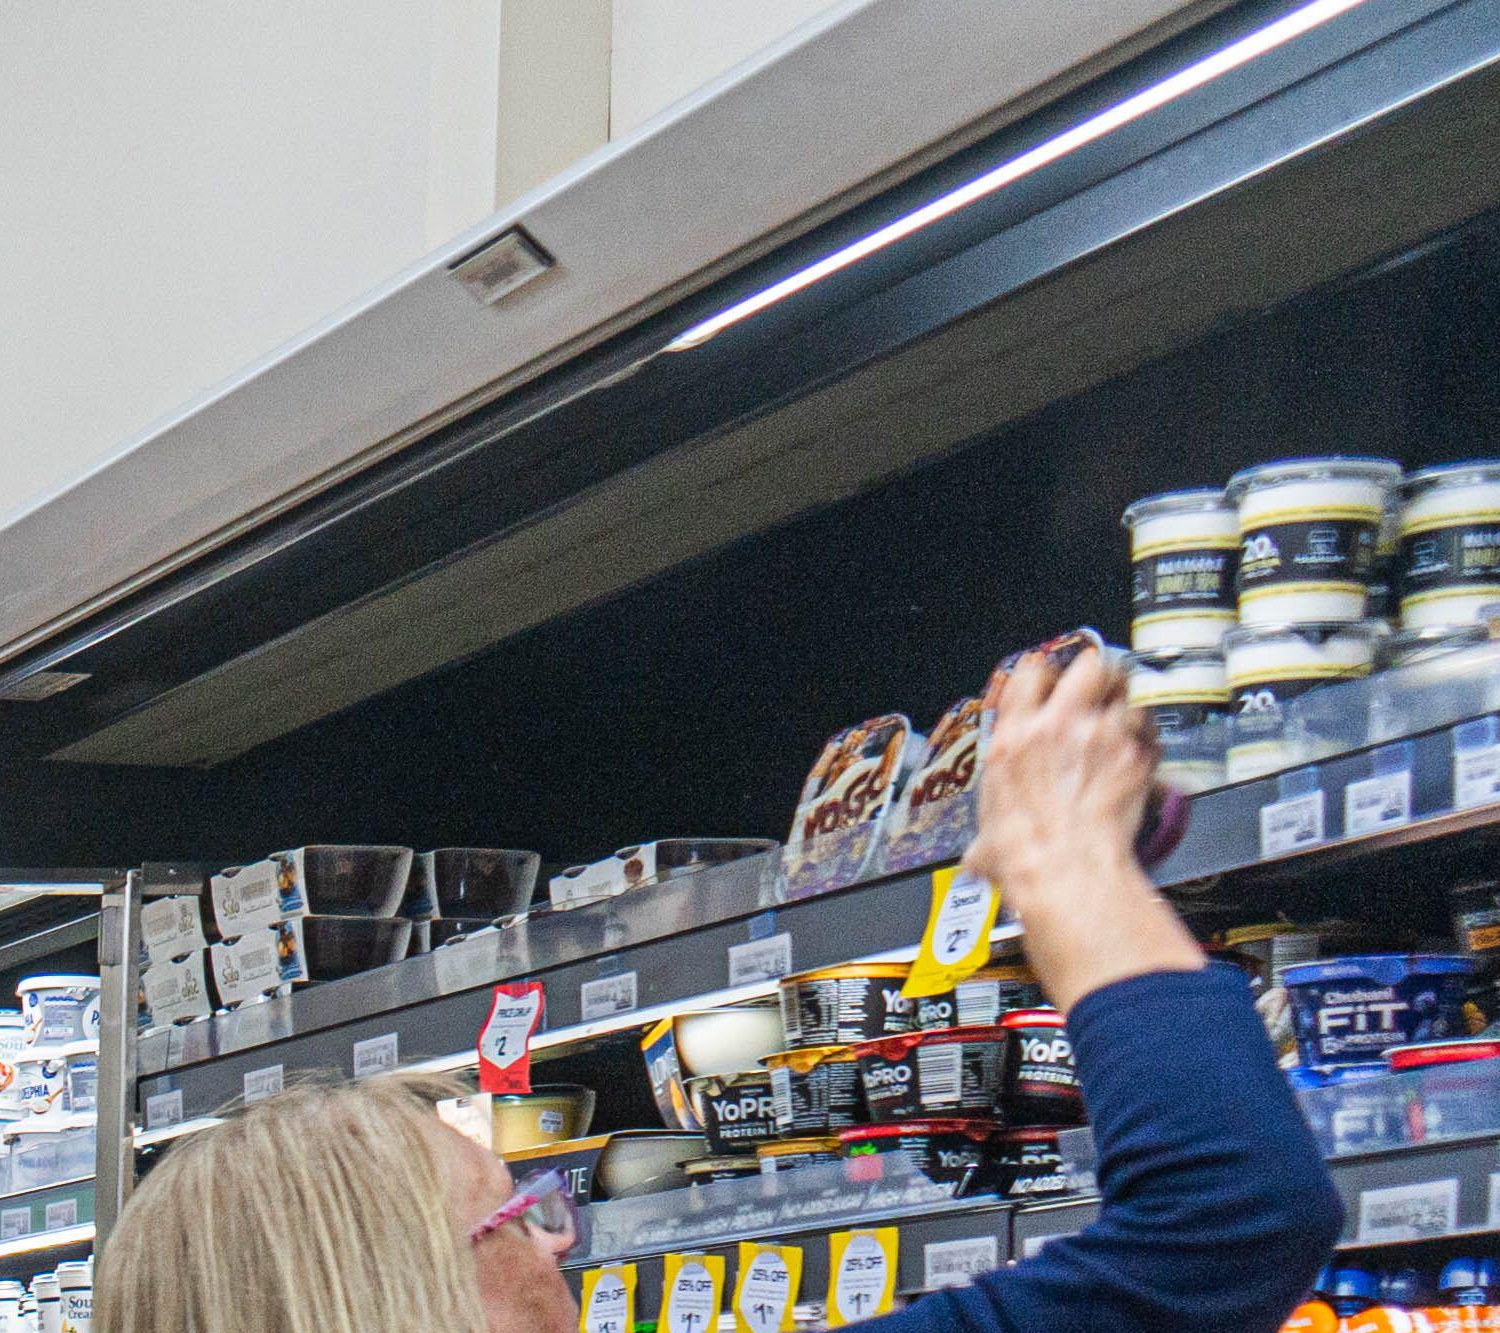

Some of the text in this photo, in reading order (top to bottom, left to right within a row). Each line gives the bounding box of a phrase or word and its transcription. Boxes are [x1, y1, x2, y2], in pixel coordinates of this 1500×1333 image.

[713, 1098, 776, 1122] YoPR
[719, 1126, 765, 1138] PROTEIN
[866, 1256, 882, 1269] OFF
[772, 1270, 788, 1282] OFF
[696, 1280, 713, 1291] OFF
[612, 1287, 626, 1300] OFF
[68, 1297, 93, 1311] Sou
